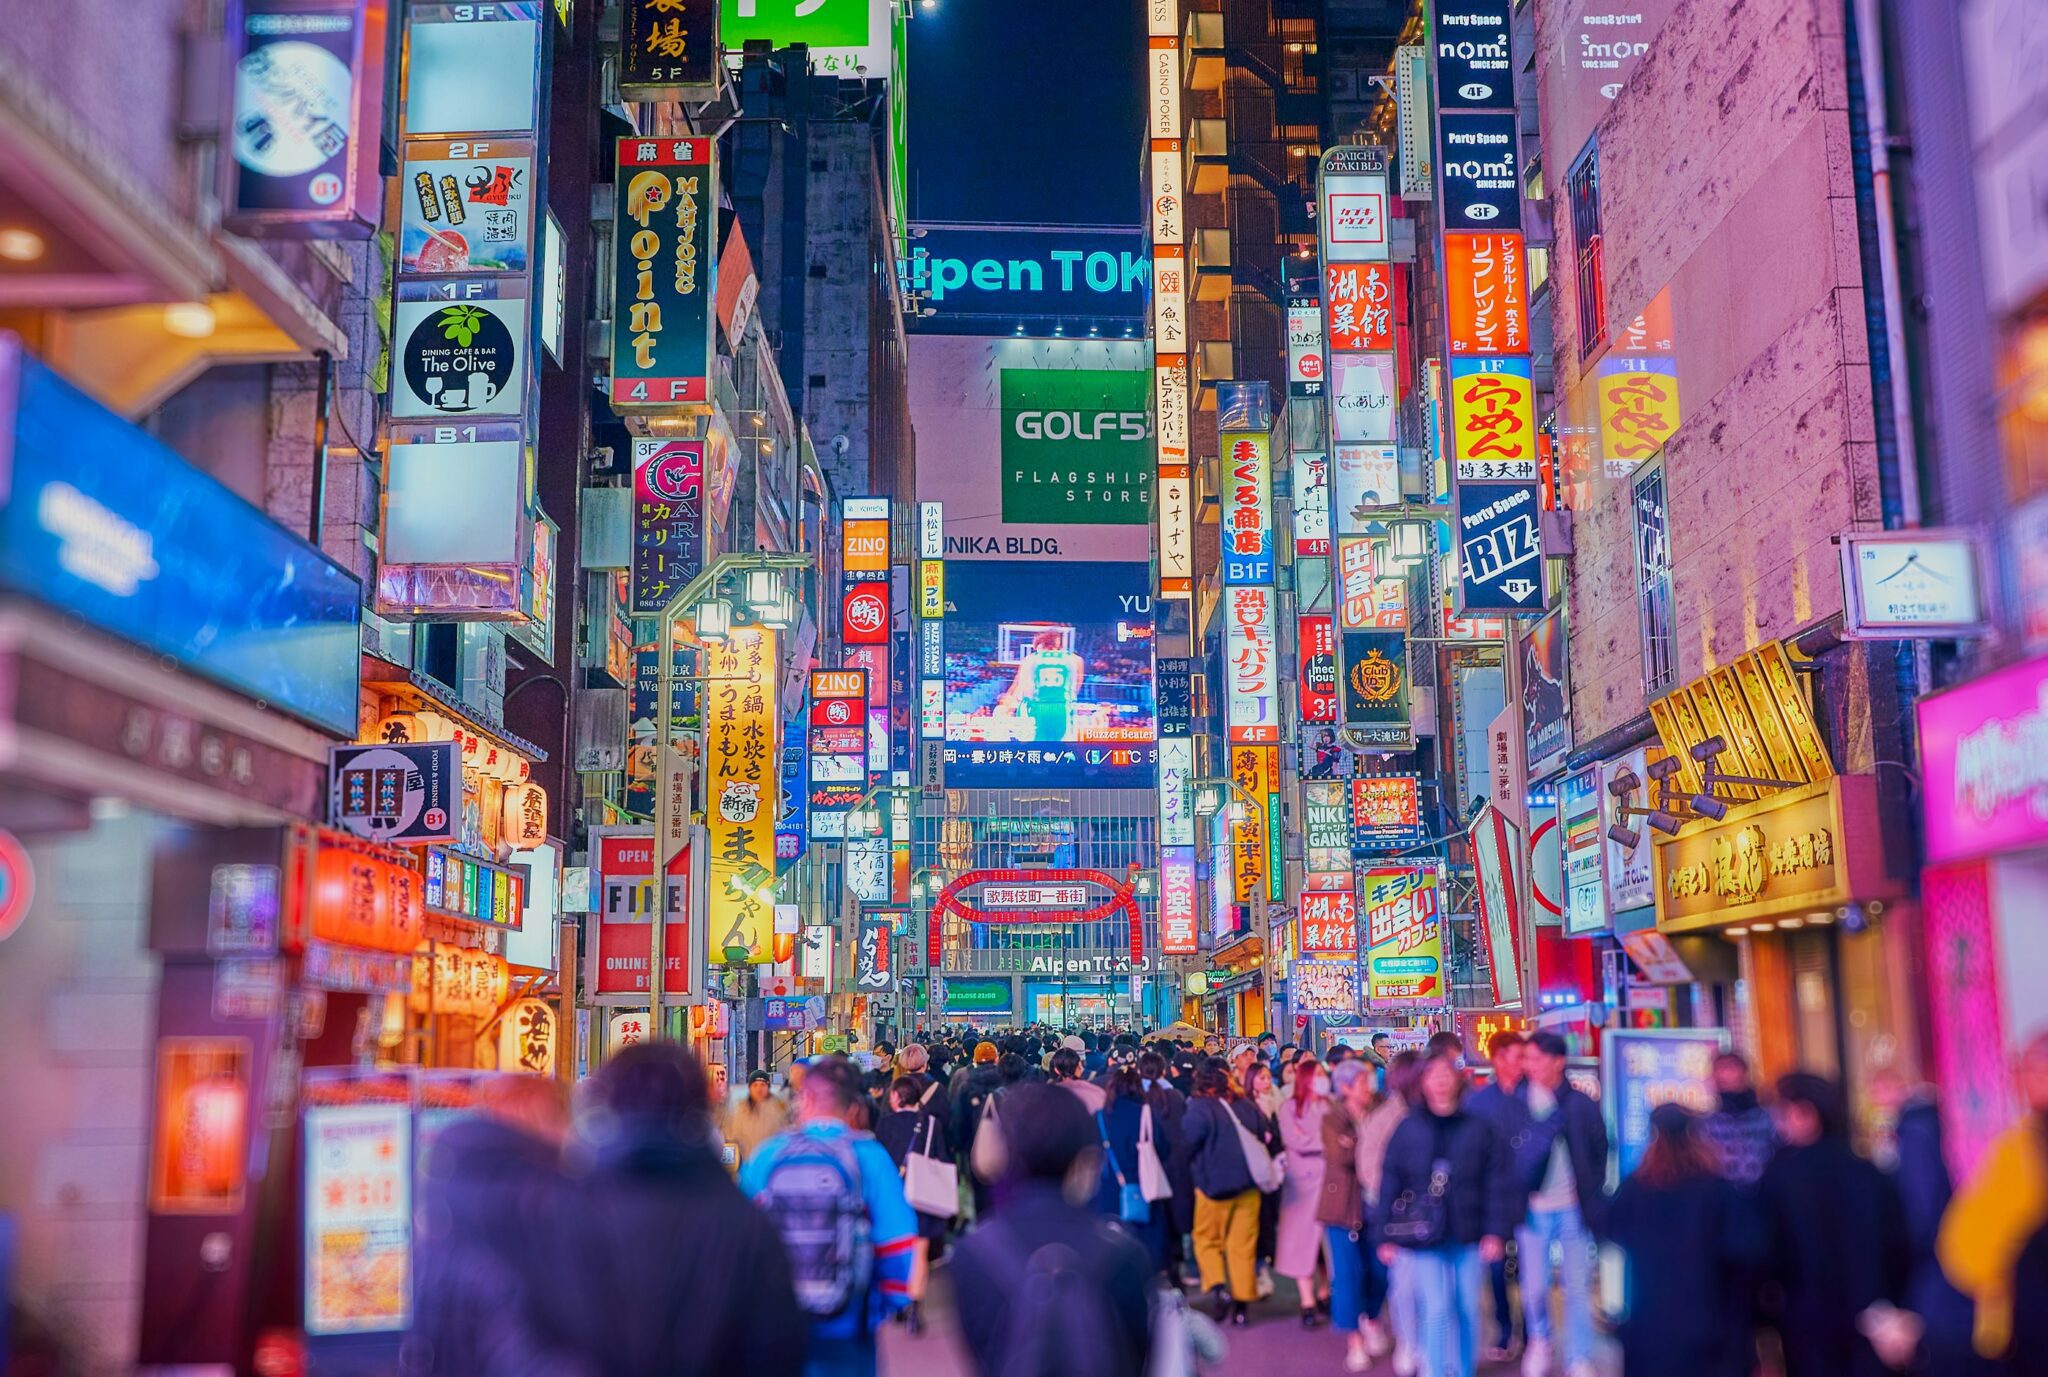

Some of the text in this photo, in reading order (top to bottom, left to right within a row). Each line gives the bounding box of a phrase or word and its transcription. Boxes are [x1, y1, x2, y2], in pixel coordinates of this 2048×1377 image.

[454, 5, 495, 21] 3F
[1443, 15, 1502, 26] Party Space
[1470, 60, 1509, 70] SINCE 2007
[651, 67, 682, 80] 5F
[1159, 53, 1171, 133] CASINO POKER
[1467, 87, 1484, 97] 4F
[1449, 133, 1508, 144] Party Space
[448, 142, 490, 158] 2F
[637, 142, 693, 162] 麻雀
[1336, 152, 1375, 161] DAIICHI
[1476, 180, 1515, 189] SINCE 2007
[416, 173, 440, 221] 食べ放題
[441, 177, 464, 224] 飲み放題
[1473, 206, 1490, 217] 3F
[675, 176, 699, 295] MAHJONG
[442, 284, 483, 298] 1F
[1329, 267, 1388, 303] 湖南
[1502, 237, 1520, 347] レンタルルーム ホステル
[1472, 237, 1498, 351] リフレッシュ
[1160, 306, 1182, 342] 魚金
[1330, 304, 1389, 336] 菜館
[1351, 336, 1373, 347] 4F
[1453, 340, 1467, 351] 2F
[422, 347, 497, 356] DINING CAFE & BAR
[422, 356, 496, 373] The Olive
[1479, 359, 1505, 373] 1F
[1305, 383, 1321, 394] 5F
[434, 427, 477, 443] B1
[638, 443, 658, 456] 3F
[1459, 461, 1533, 478] 博多天神
[1066, 490, 1148, 503] STORE
[1232, 440, 1264, 556] まぐろ商店
[1462, 489, 1531, 530] Party Space
[926, 505, 938, 555] 小松ビル
[651, 503, 671, 599] カリーナ
[847, 537, 886, 552] ZINO
[1308, 540, 1329, 553] 4F
[1228, 561, 1269, 580] B1F
[1345, 542, 1373, 625] 出会い
[1509, 582, 1528, 593] B1
[1382, 613, 1402, 626] 1F
[816, 673, 860, 690] ZINO
[1086, 729, 1153, 739] Buzzer Beater
[1163, 723, 1186, 733] 3F
[1241, 727, 1267, 741] 4F
[743, 719, 765, 780] 水炊き
[1496, 731, 1510, 800] 劇場通り一番街
[722, 794, 756, 812] 新宿
[1164, 768, 1180, 824] バンタイ
[671, 772, 684, 838] 劇場通り一番街
[425, 813, 444, 825] B1
[522, 788, 543, 839] 居酒屋
[733, 811, 746, 823] の
[618, 850, 648, 863] OPEN
[1163, 849, 1176, 857] 2F
[870, 839, 886, 887] 居酒屋
[1320, 875, 1345, 889] 2F
[1371, 869, 1426, 903] キラリ
[986, 889, 1084, 904] 歌舞伎町一番街
[1166, 864, 1192, 944] 安楽亭
[1303, 893, 1356, 924] 湖南
[1370, 888, 1434, 945] 出会い
[1305, 923, 1345, 951] 菜館
[1396, 922, 1438, 956] カフェ
[606, 957, 648, 970] ONLINE
[1031, 956, 1092, 976] Alpen
